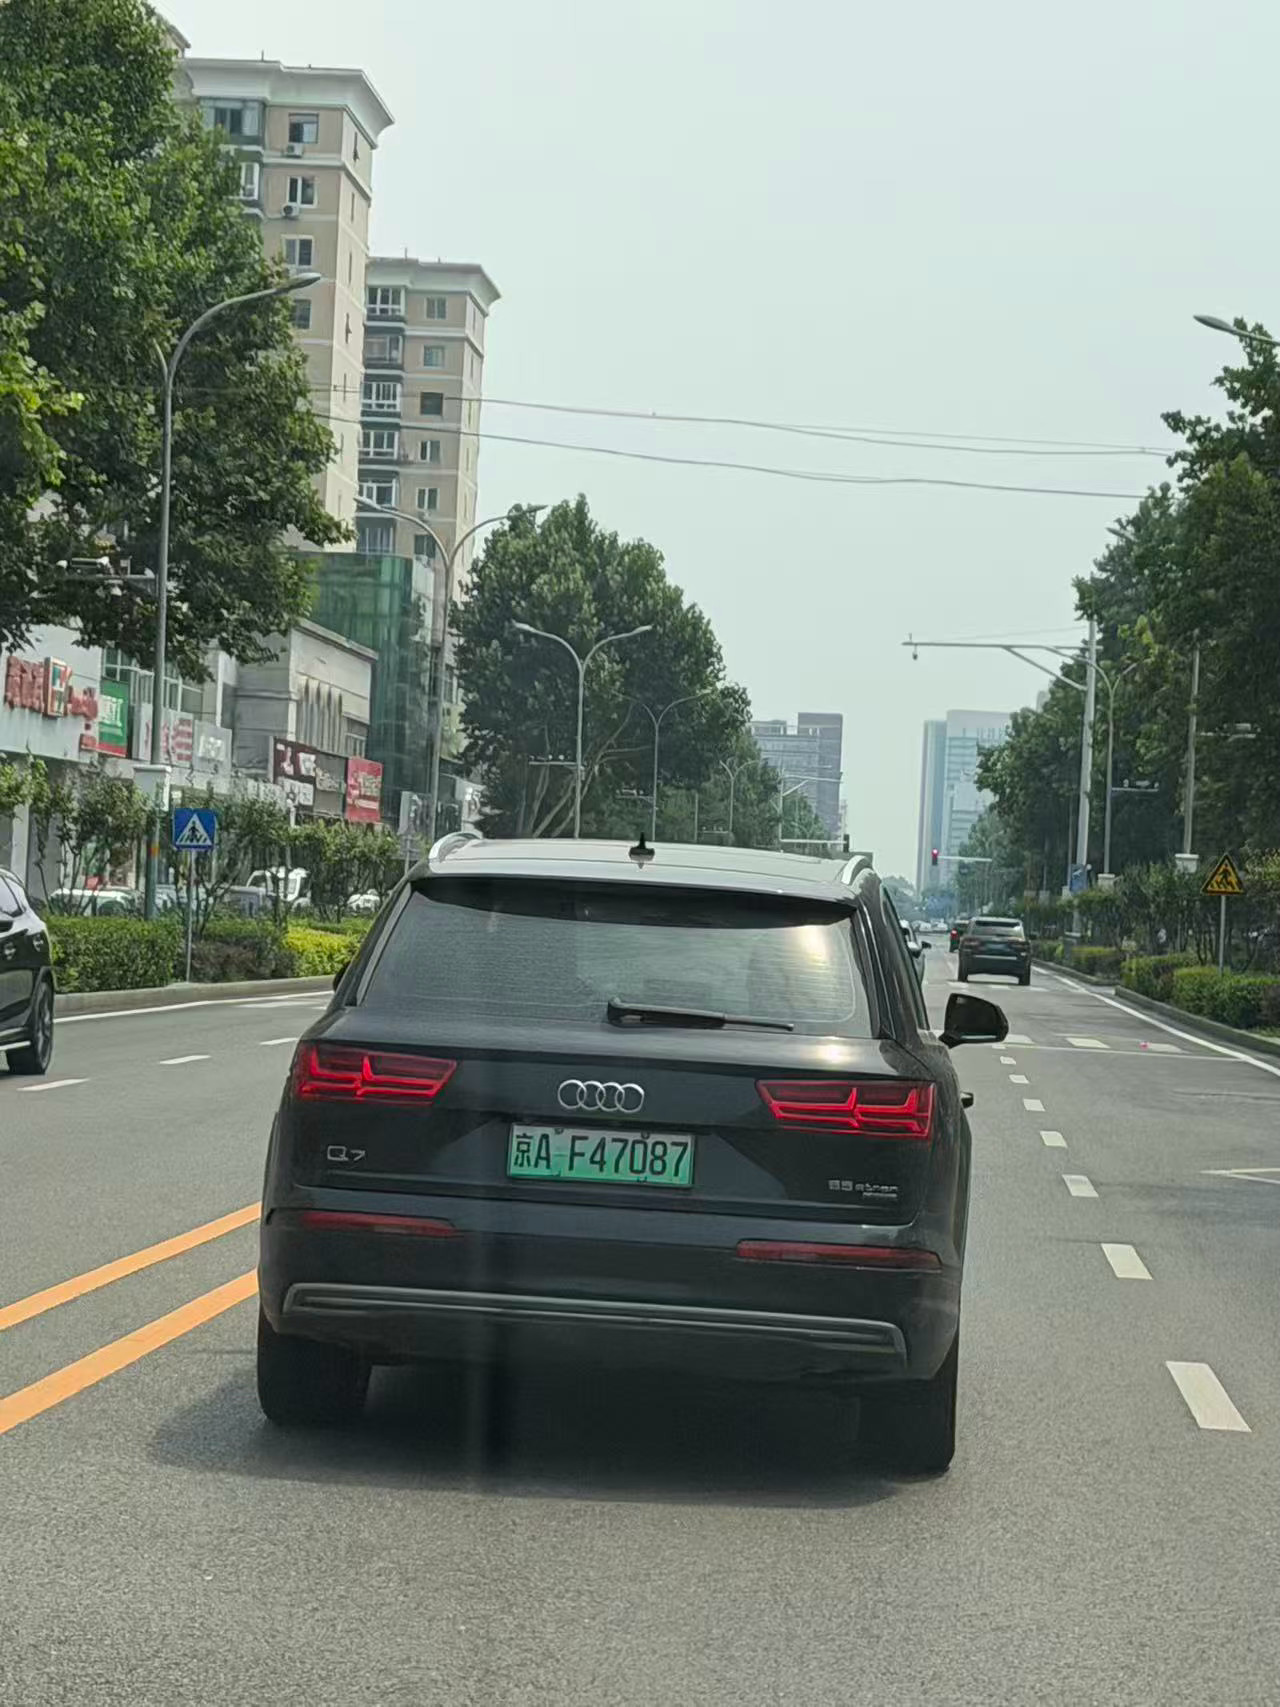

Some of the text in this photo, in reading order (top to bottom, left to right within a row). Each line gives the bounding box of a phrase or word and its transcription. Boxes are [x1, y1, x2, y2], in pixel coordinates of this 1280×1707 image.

[327, 1145, 366, 1161] Q7
[513, 1133, 689, 1178] 京A F47087
